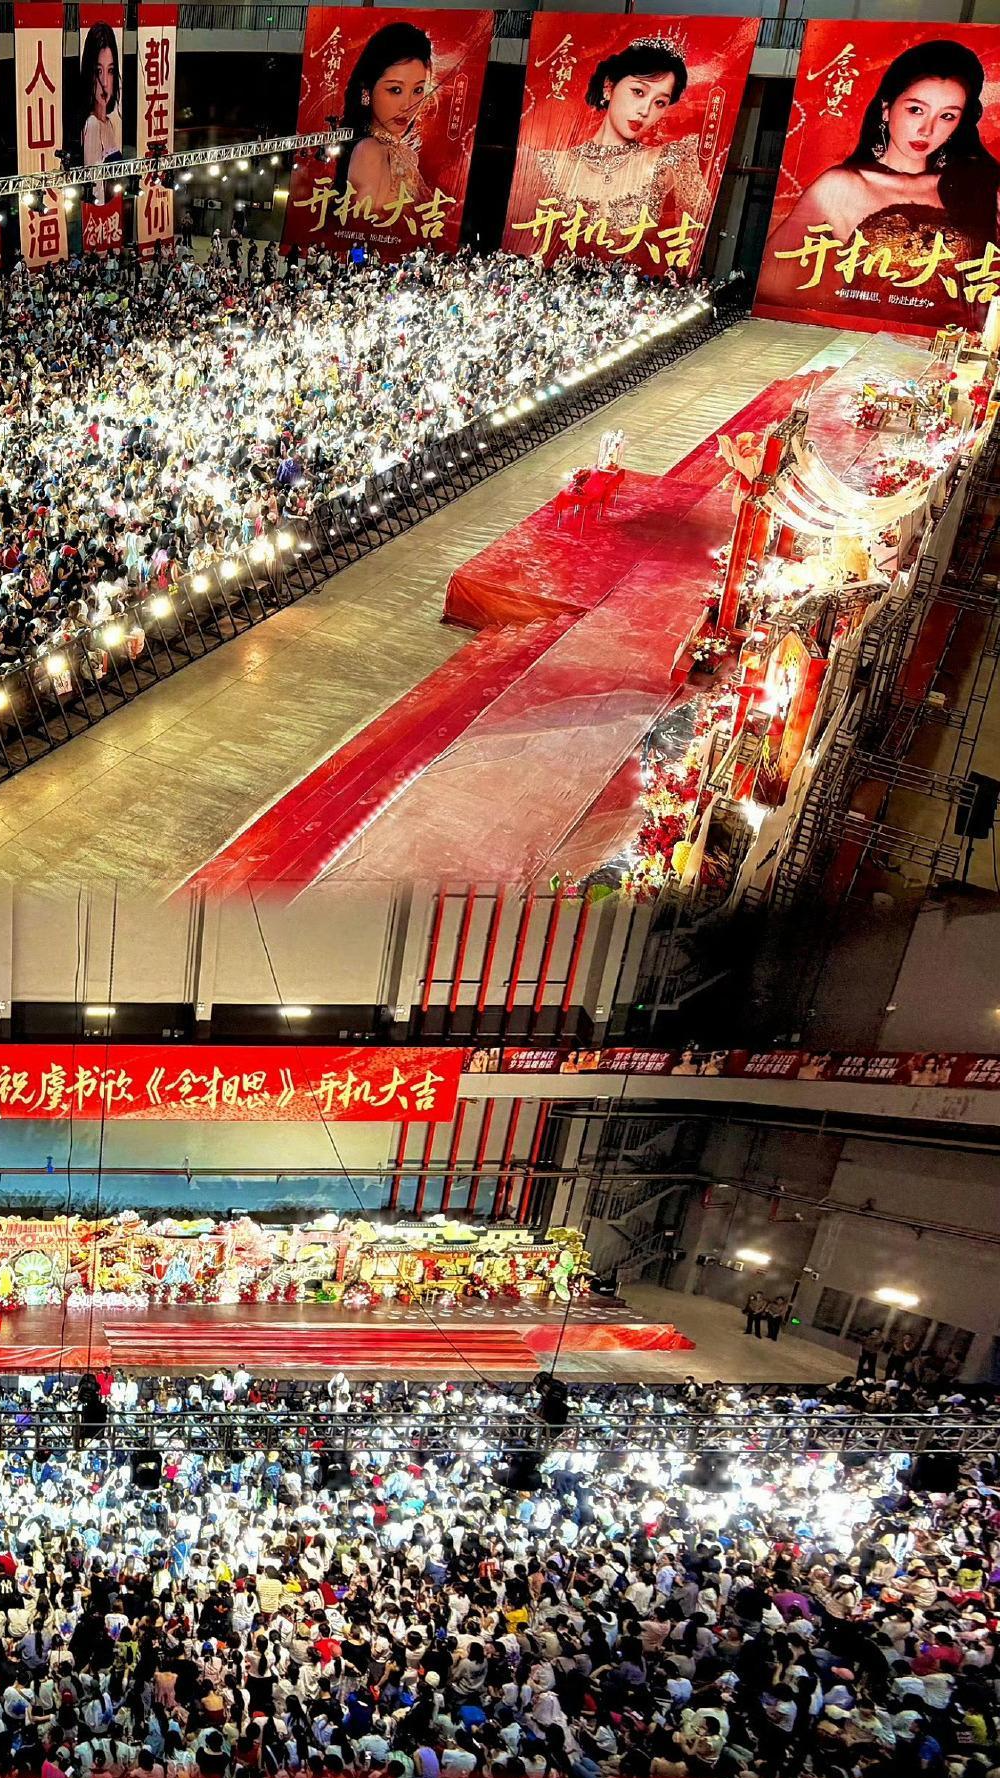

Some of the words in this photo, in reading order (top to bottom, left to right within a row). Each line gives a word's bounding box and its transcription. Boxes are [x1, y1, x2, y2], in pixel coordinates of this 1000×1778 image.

[535, 34, 577, 100] 念相思
[807, 43, 860, 118] 念相思
[83, 211, 123, 246] 念相思
[294, 178, 456, 238] 开机大吉
[512, 198, 705, 267] 开机大吉
[775, 224, 1000, 304] 开机大吉
